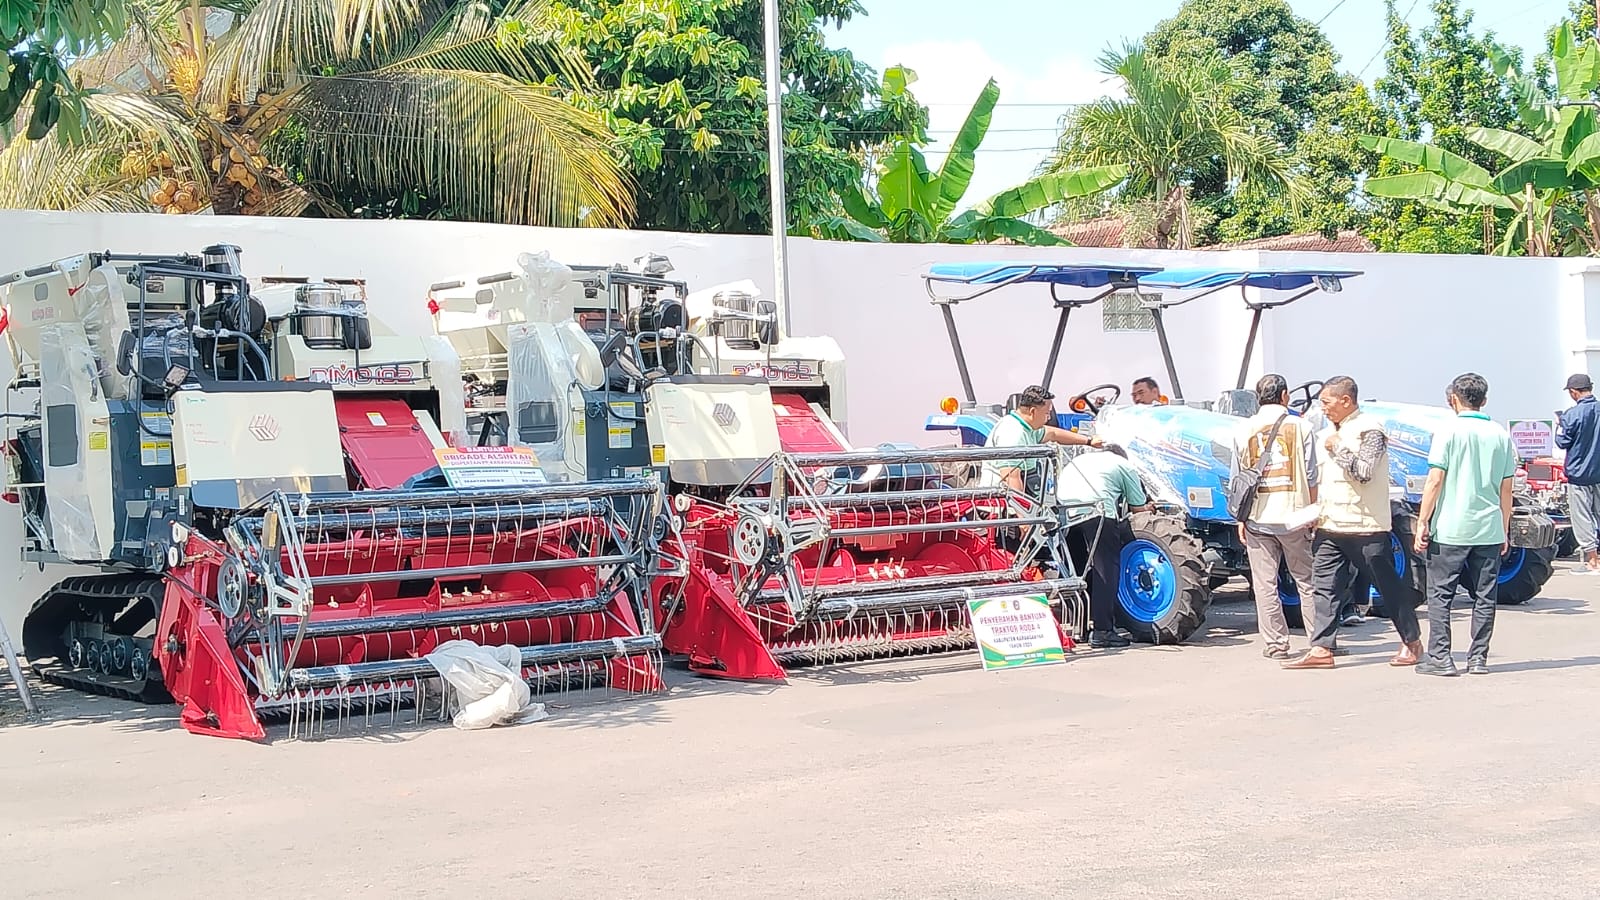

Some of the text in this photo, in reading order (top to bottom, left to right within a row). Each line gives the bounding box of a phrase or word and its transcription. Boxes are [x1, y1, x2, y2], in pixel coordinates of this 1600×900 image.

[443, 453, 532, 461] BRIGADE ALSINTAN
[980, 612, 1046, 625] PENYERAHAN BANTUAN
[991, 625, 1018, 634] TRAKTOR
